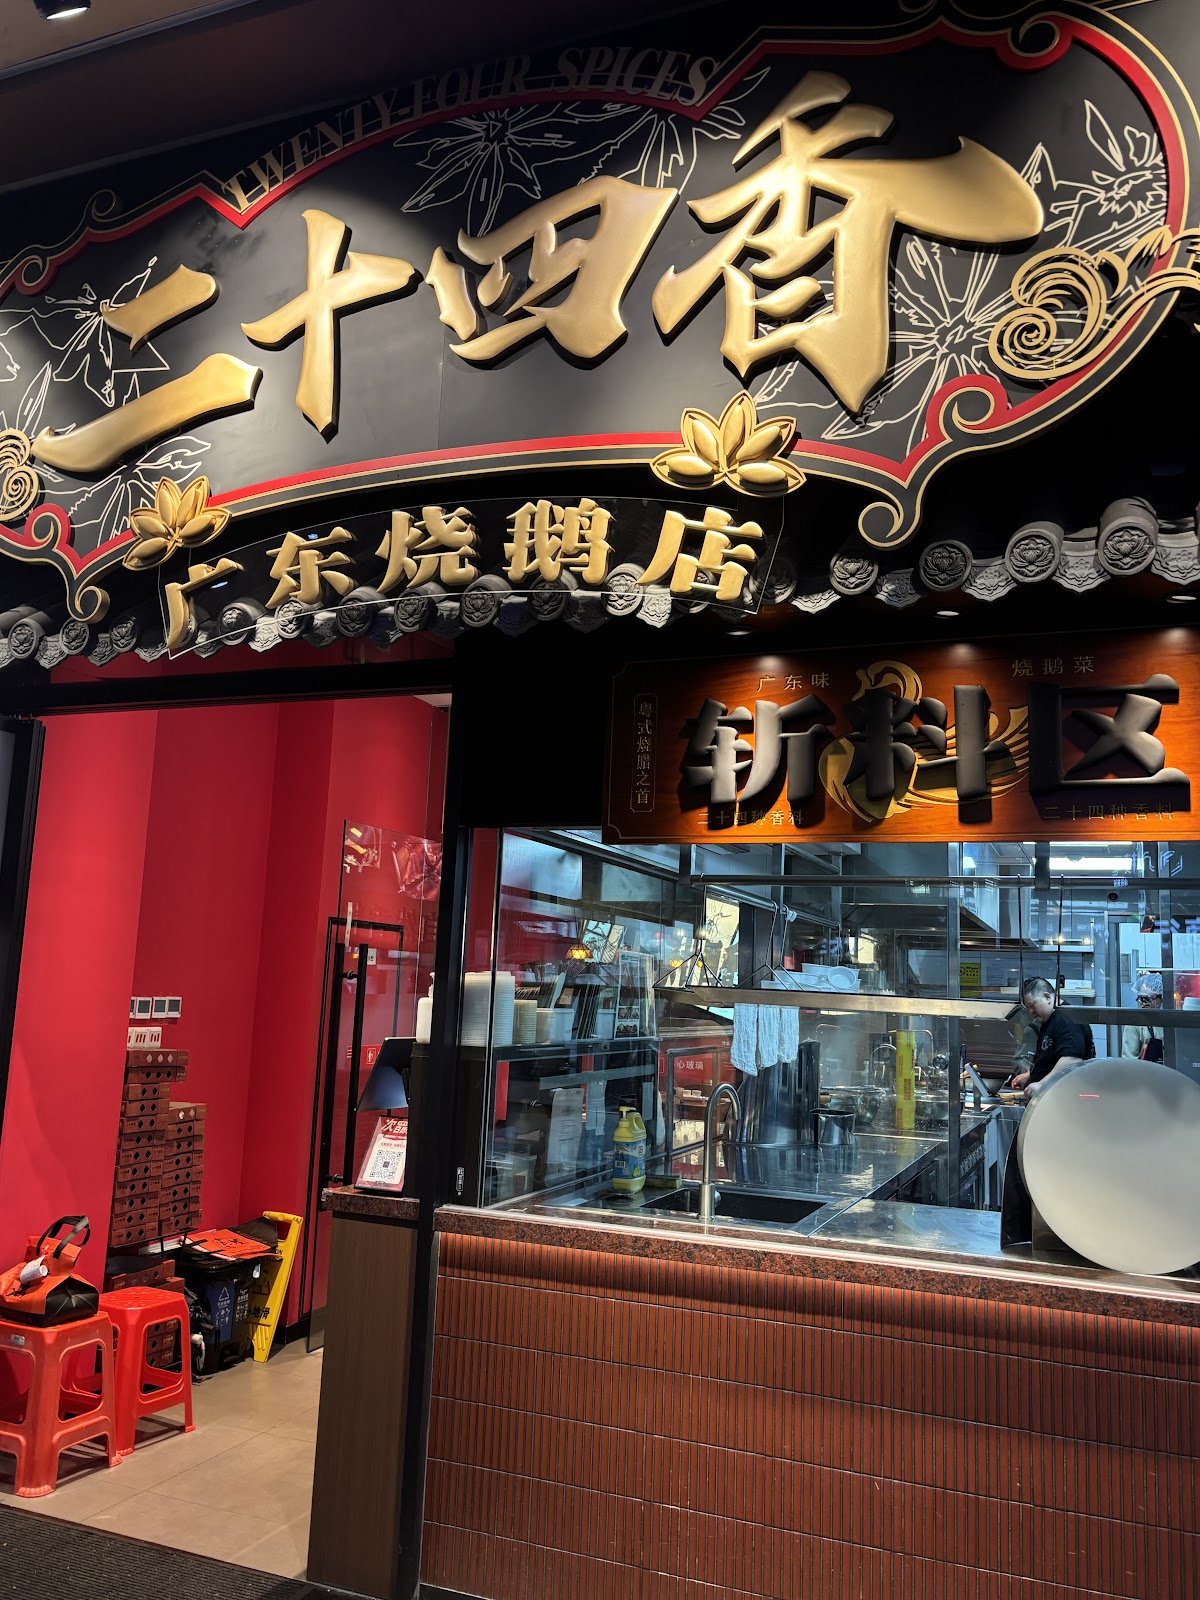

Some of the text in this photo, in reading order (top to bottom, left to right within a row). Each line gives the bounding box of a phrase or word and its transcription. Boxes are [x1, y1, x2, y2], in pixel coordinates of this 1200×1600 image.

[221, 46, 721, 213] TWENTY-FOUR SPICES
[32, 71, 1044, 471] 二十四香
[166, 497, 764, 650] 广东烧鹅店
[756, 671, 830, 693] 广东味
[1011, 655, 1095, 678] 烧鹅菜
[635, 701, 653, 804] 粤式烧腊之首
[682, 673, 1191, 803] 斩料区
[697, 808, 805, 826] 二十四种香料
[1043, 802, 1175, 821] 二十四种香料
[675, 1059, 704, 1071] 心玻璃
